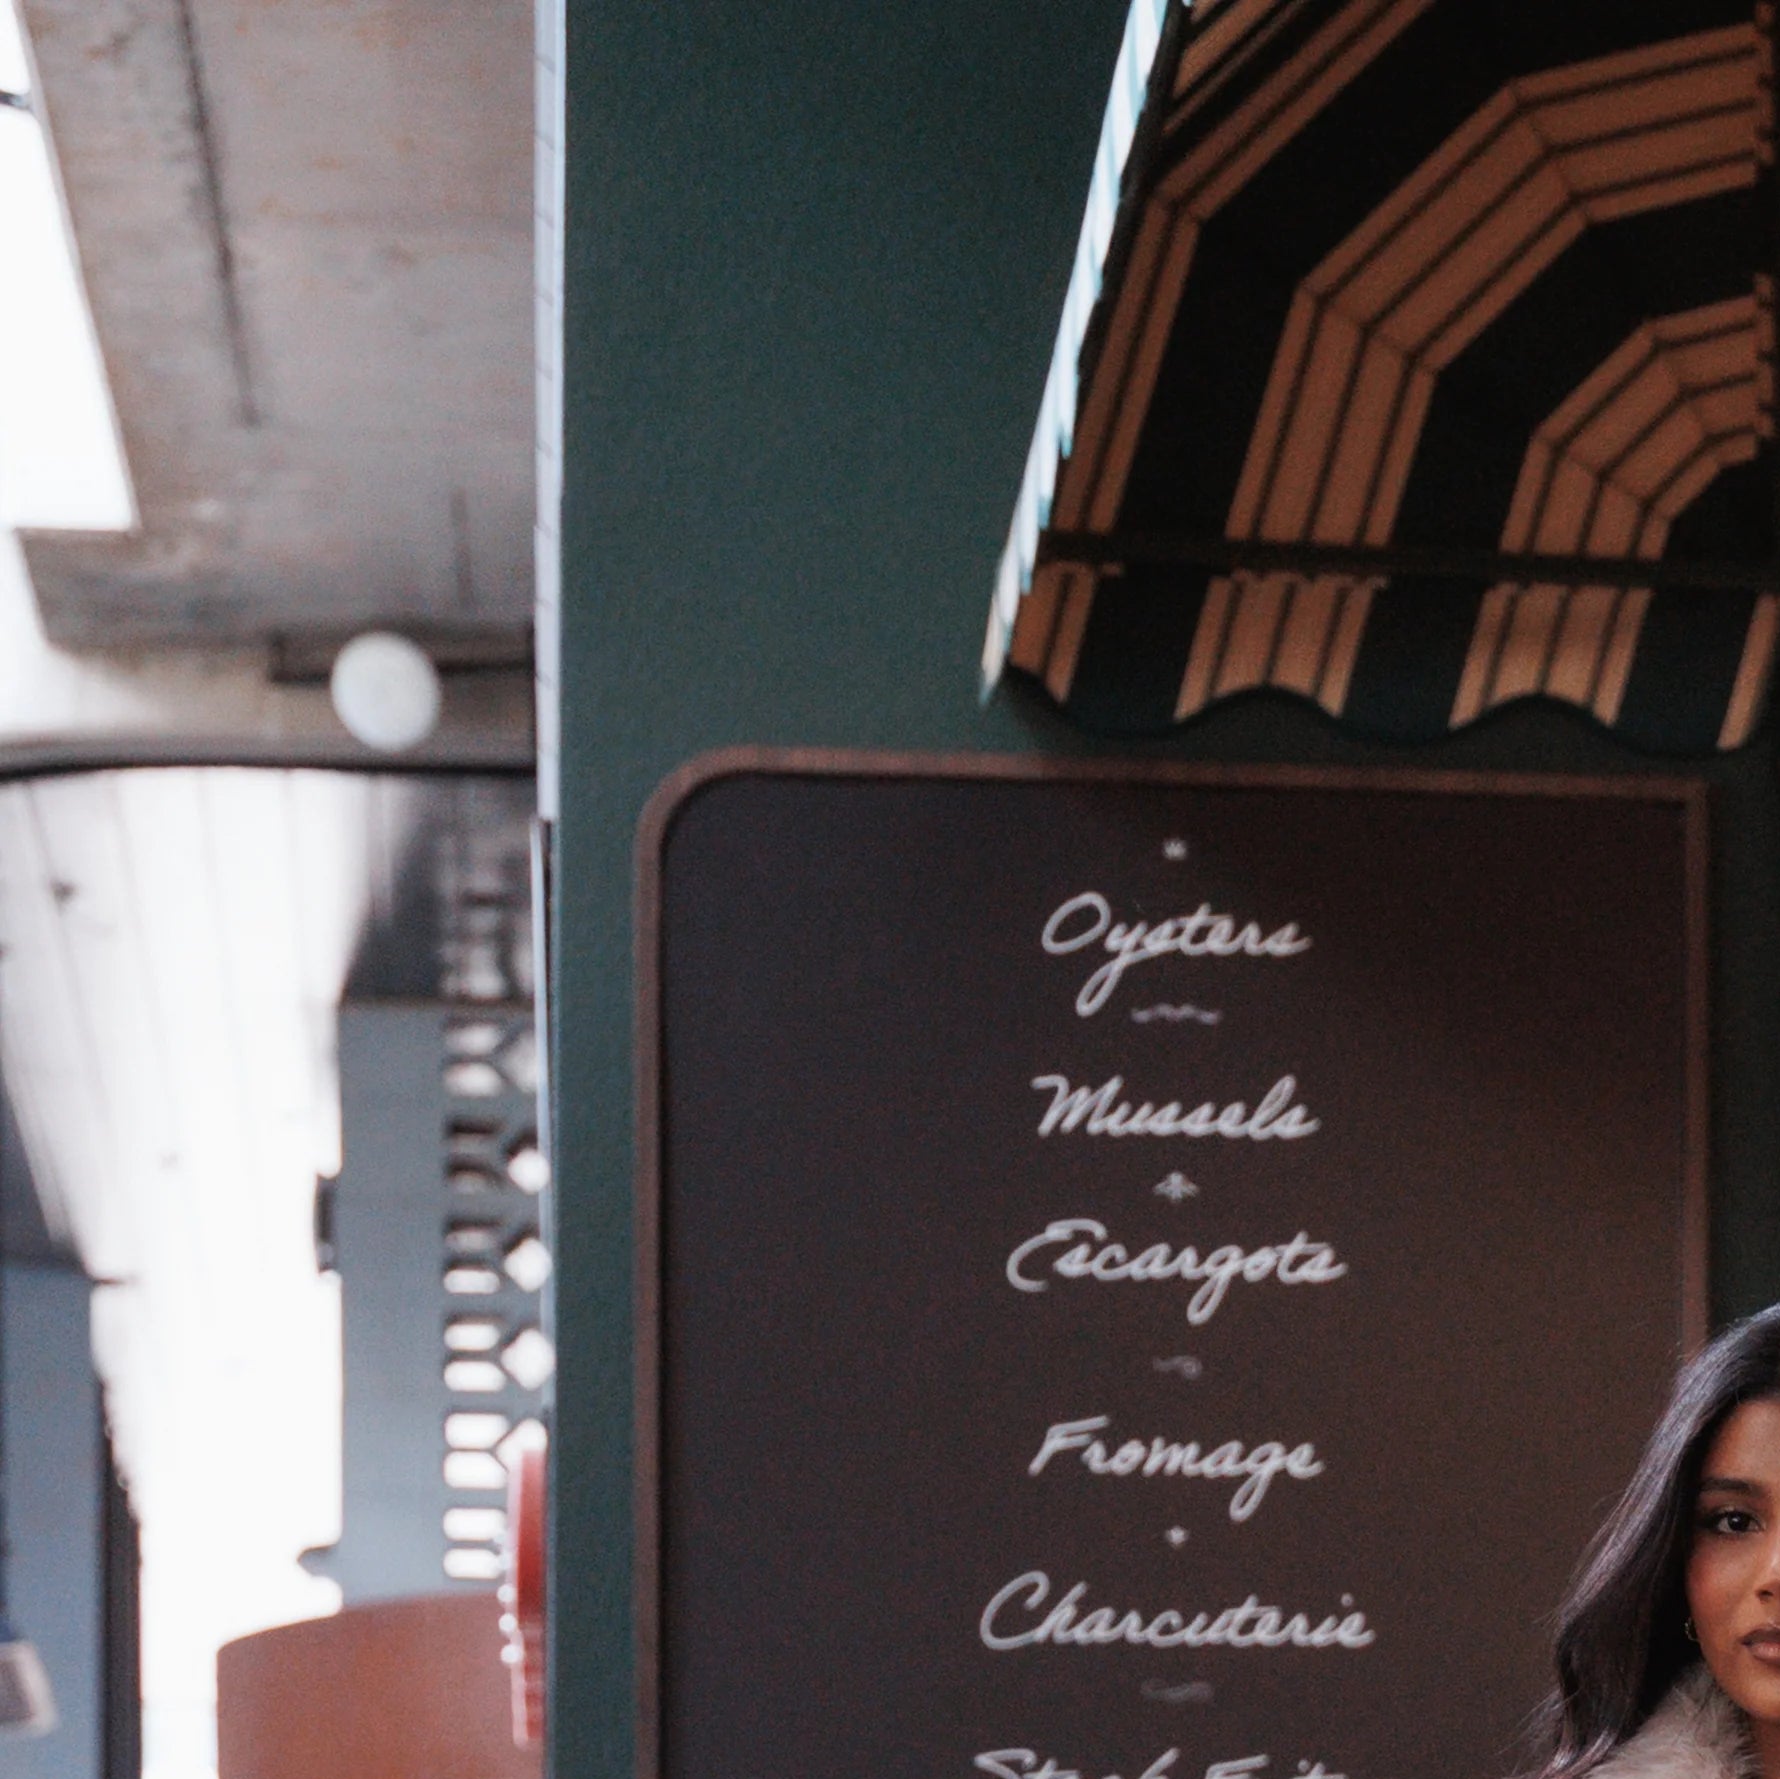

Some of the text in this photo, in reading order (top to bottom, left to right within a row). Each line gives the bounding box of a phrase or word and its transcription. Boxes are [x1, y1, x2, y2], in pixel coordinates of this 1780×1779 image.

[1042, 892, 1311, 1015] Oysters
[1031, 1074, 1320, 1140] Mussels
[1006, 1218, 1347, 1325] Escargots
[1028, 1416, 1323, 1521] Fromage
[980, 1571, 1375, 1650] Charcuterie
